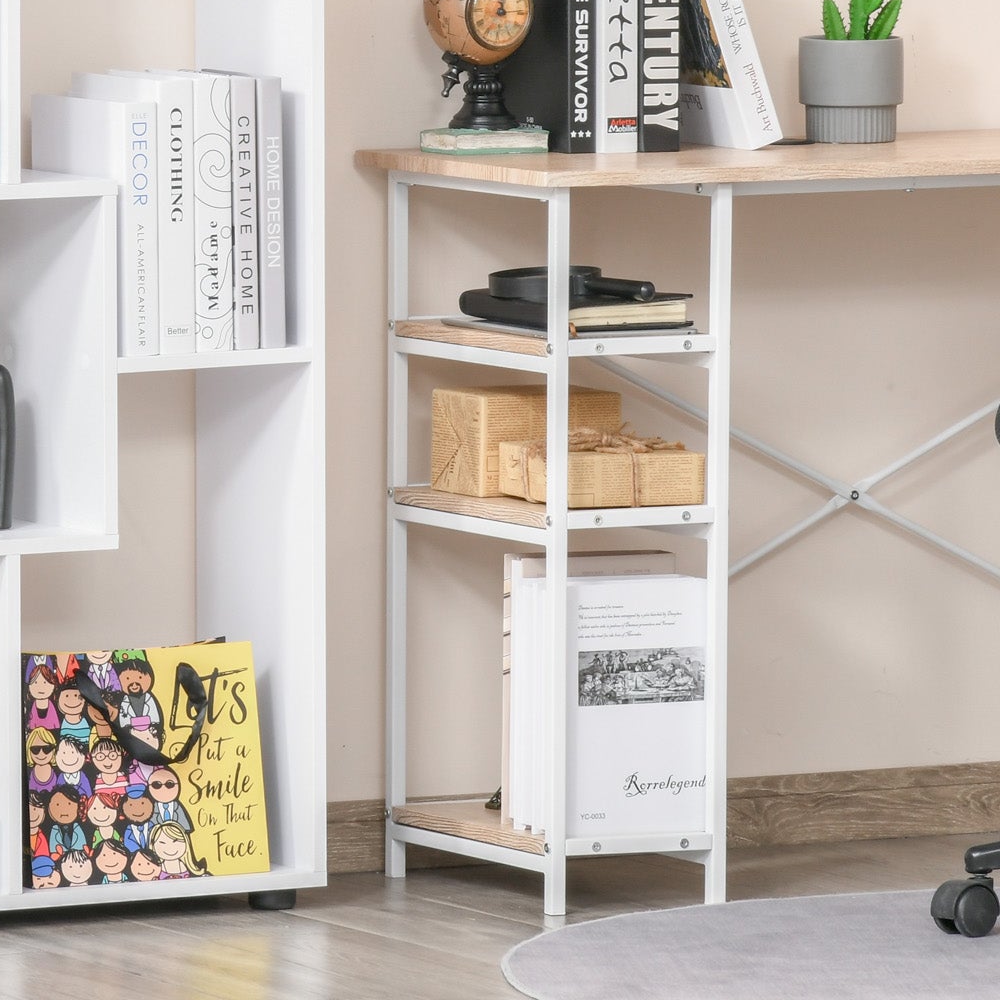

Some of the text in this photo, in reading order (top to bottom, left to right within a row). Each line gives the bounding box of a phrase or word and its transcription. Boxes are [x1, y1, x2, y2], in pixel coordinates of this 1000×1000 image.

[574, 9, 589, 123] SURVIVOR
[723, 13, 743, 56] WHOSE
[742, 62, 774, 132] Art Buchwald
[132, 121, 148, 207] DECOR
[169, 107, 183, 223] CLOTHING
[266, 136, 280, 193] HOME
[237, 115, 254, 316] CREATIVE HOME
[208, 220, 219, 311] Madame
[188, 762, 254, 805] Smile
[196, 732, 251, 765] Put a
[197, 802, 258, 828] On That
